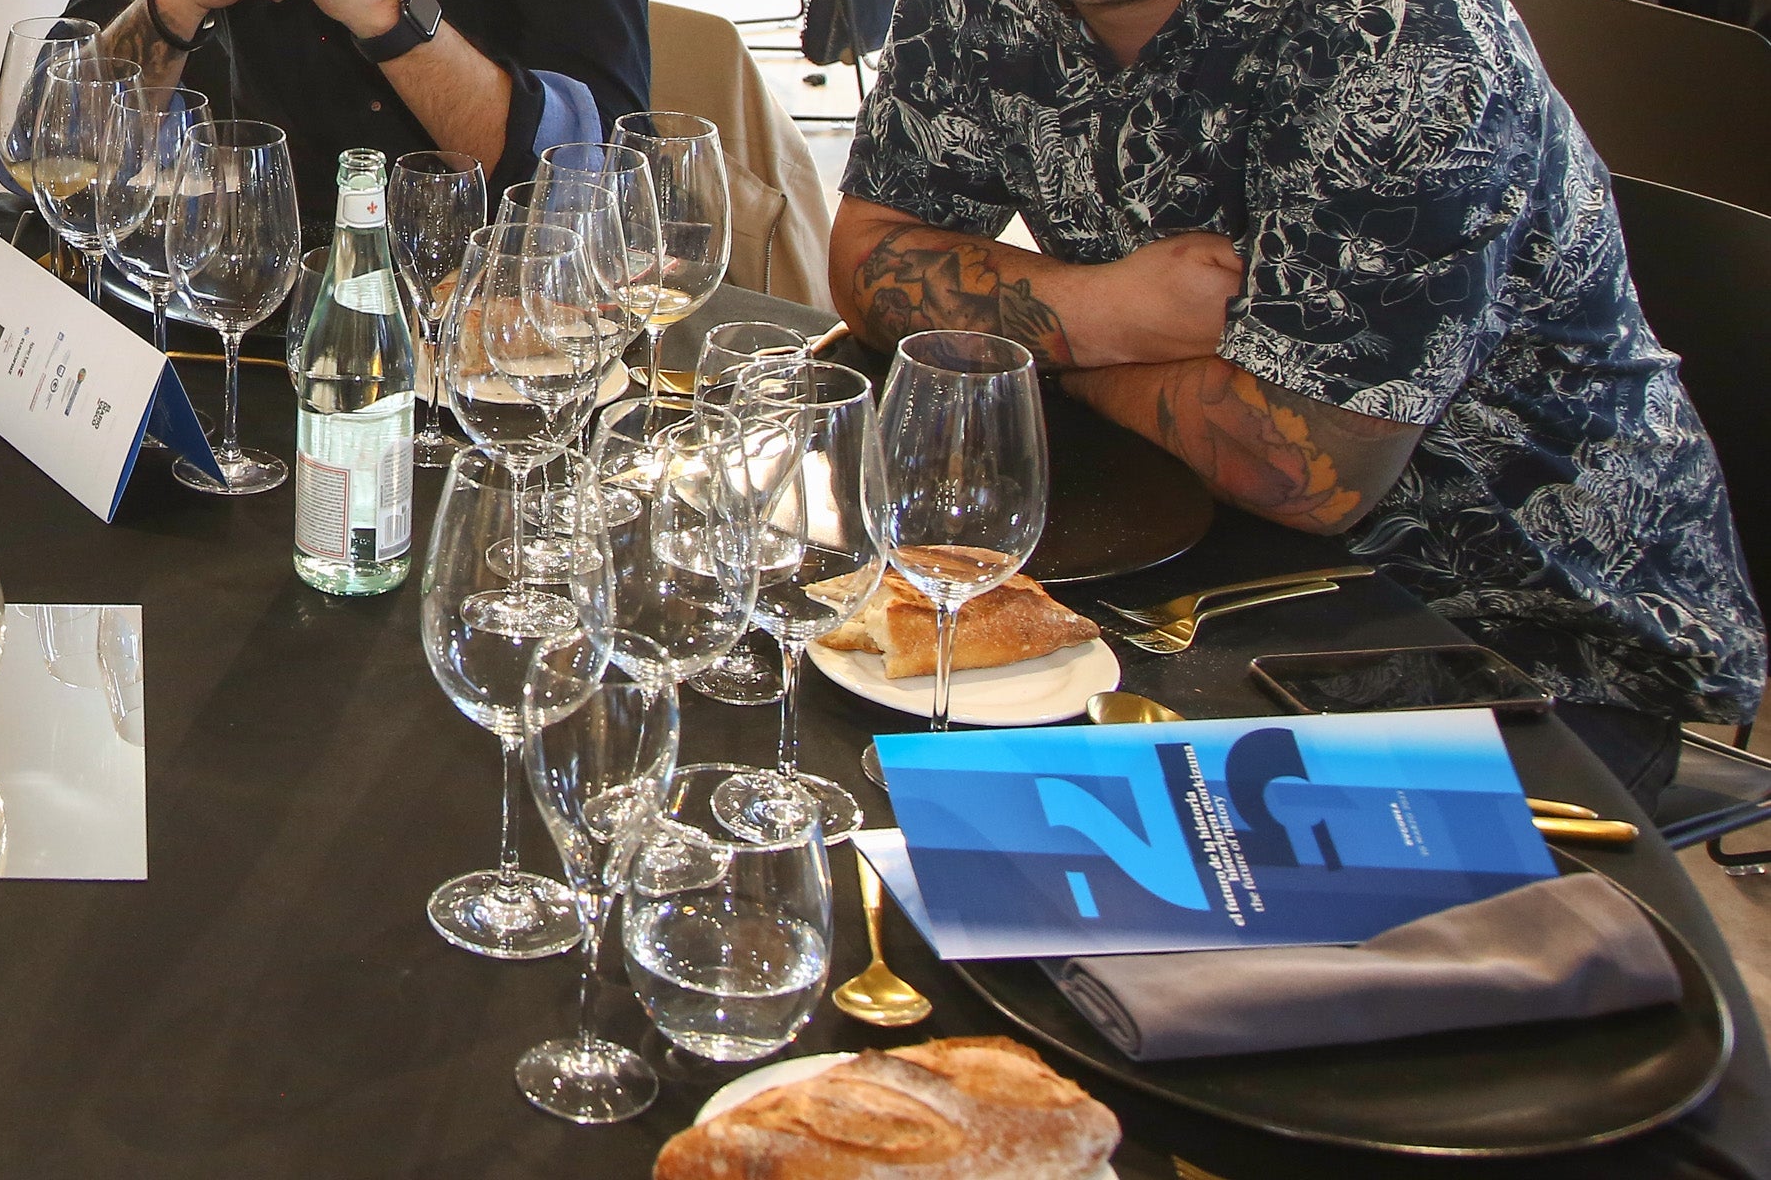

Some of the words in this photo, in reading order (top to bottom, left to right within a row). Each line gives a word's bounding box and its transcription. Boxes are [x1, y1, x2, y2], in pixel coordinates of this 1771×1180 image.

[1184, 745, 1214, 813] etorkizuna
[1185, 790, 1212, 840] historia
[1213, 795, 1236, 836] history
[1203, 840, 1216, 852] la
[1207, 814, 1240, 882] historiaren
[1228, 834, 1241, 851] of
[1208, 854, 1222, 869] de
[1234, 853, 1256, 890] future
[1215, 870, 1240, 914] futuro
[1248, 892, 1265, 913] the
[1229, 913, 1245, 927] el
